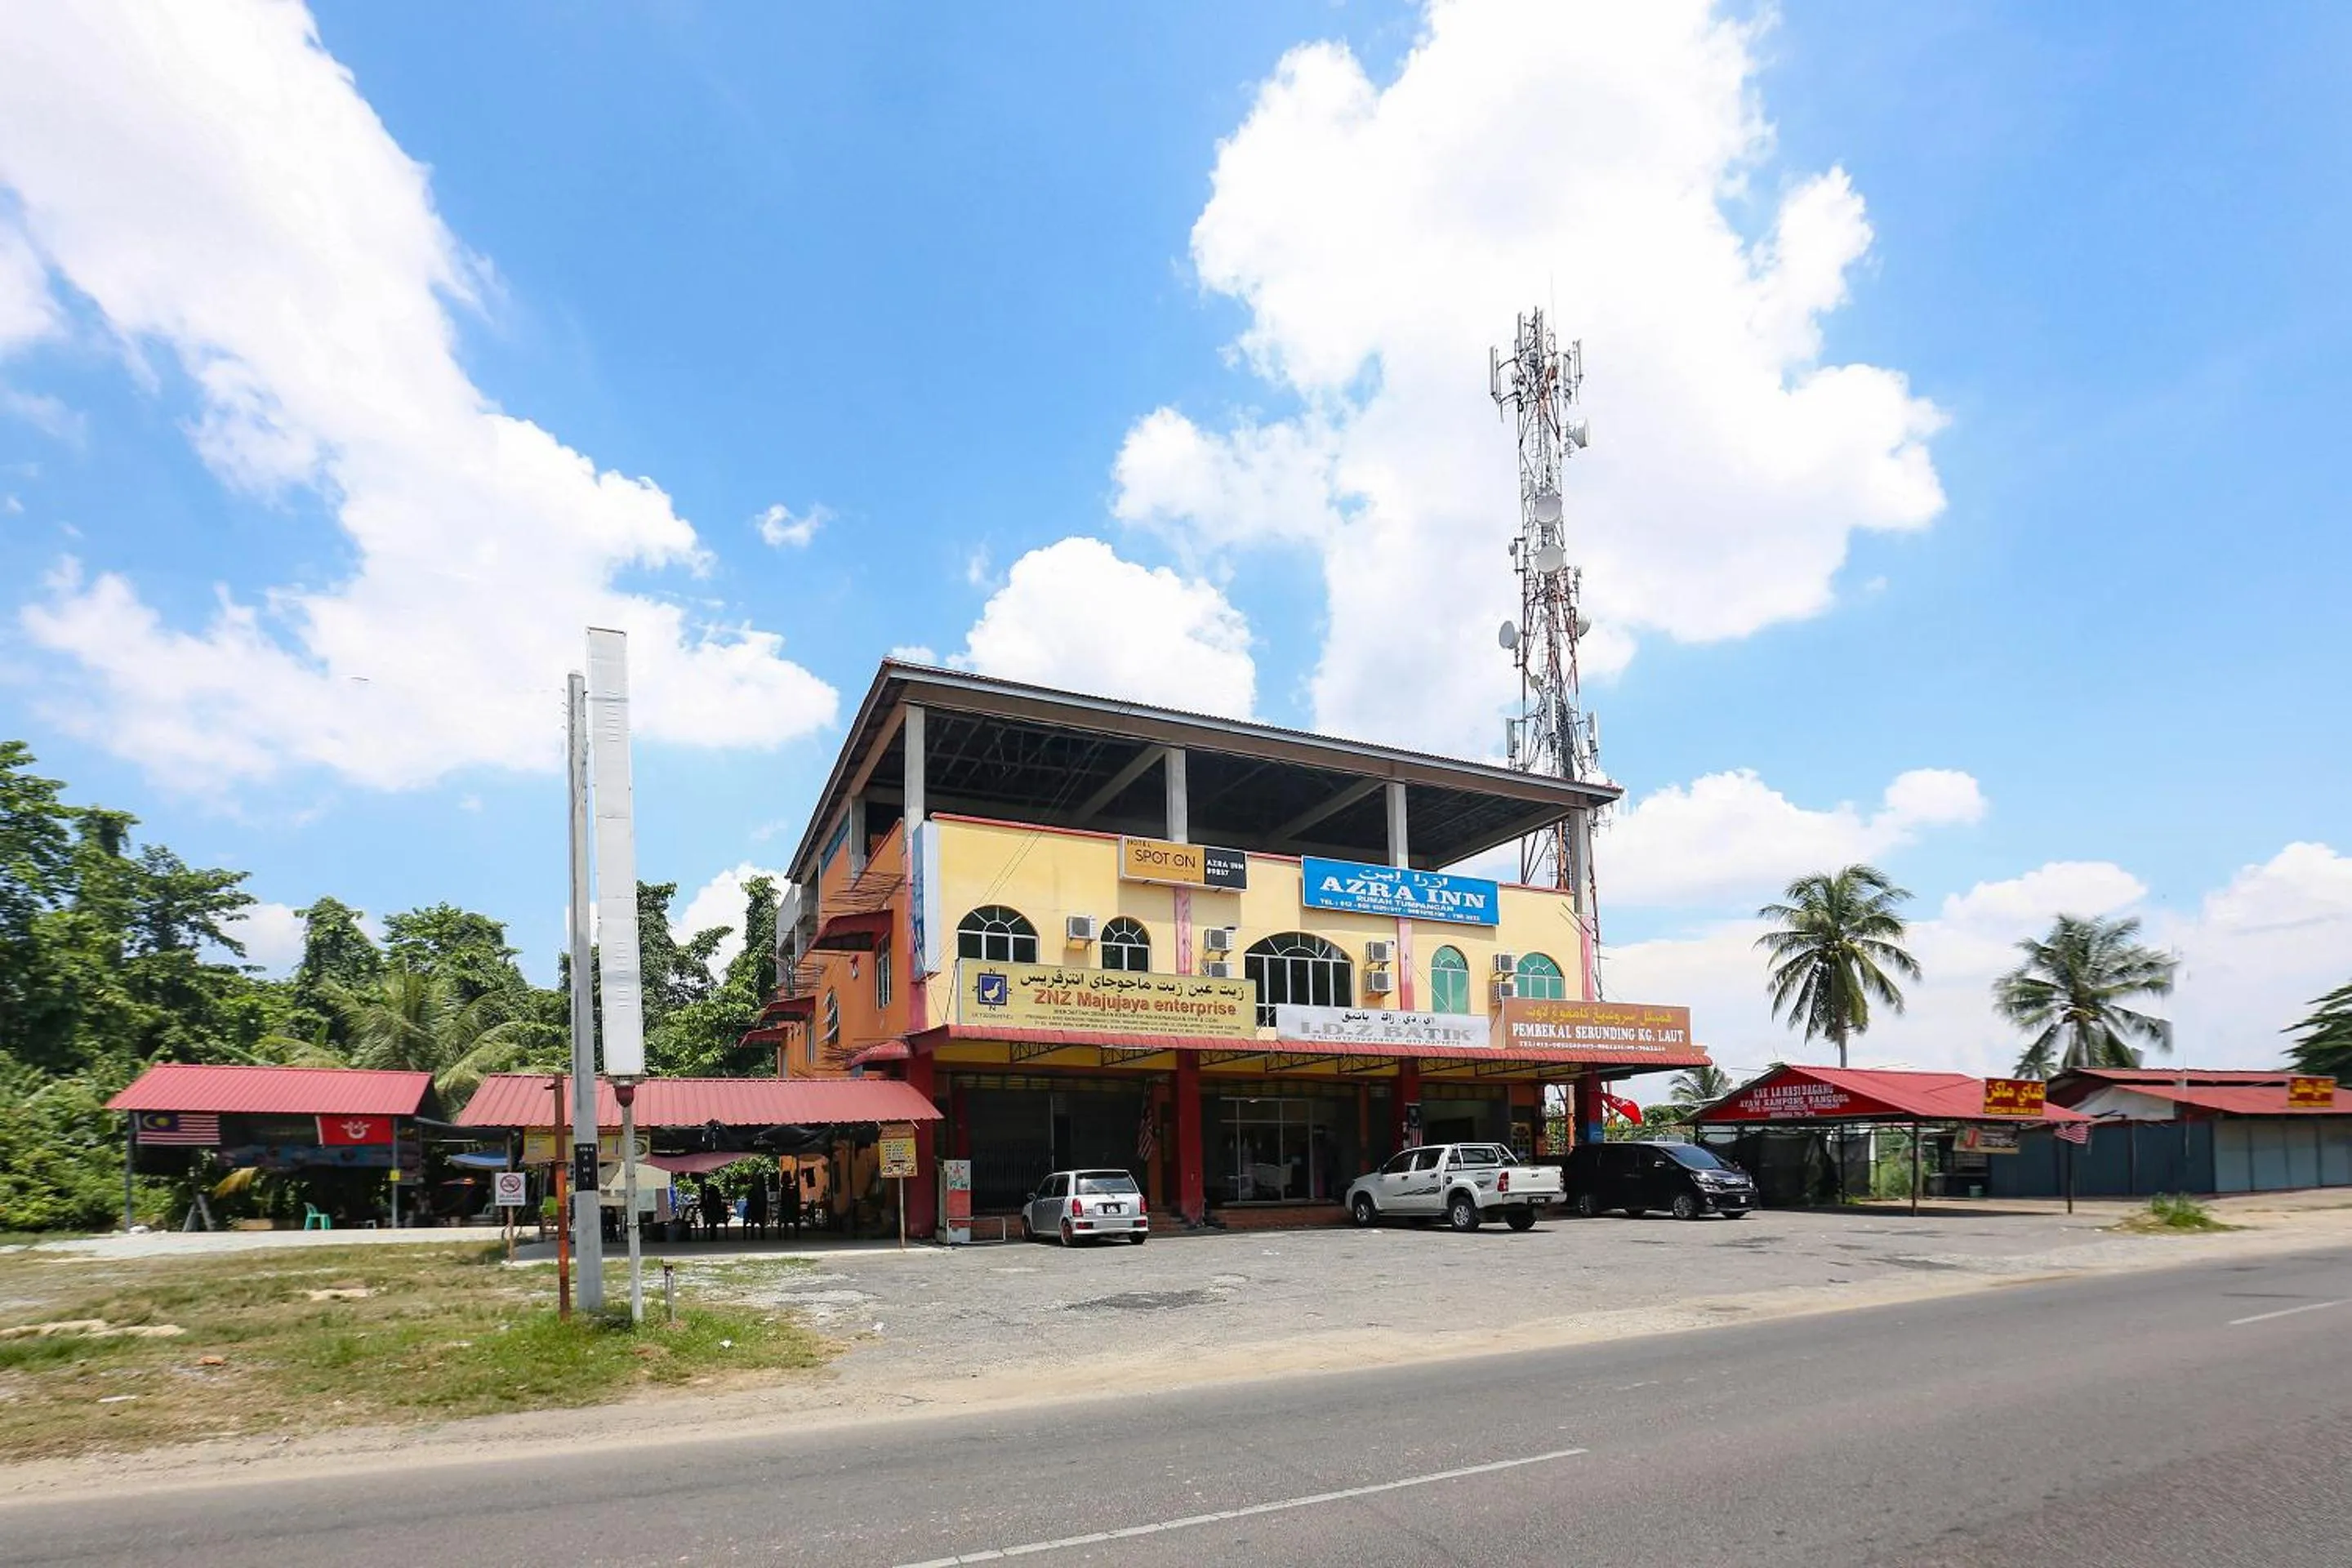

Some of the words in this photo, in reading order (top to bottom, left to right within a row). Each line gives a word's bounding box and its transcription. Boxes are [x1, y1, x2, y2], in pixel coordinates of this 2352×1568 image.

[1135, 849, 1170, 864] SPOT
[1174, 854, 1196, 868] ON
[1206, 859, 1228, 869] AZRA
[1320, 876, 1415, 902] AZRA
[1427, 888, 1486, 908] INN
[1356, 894, 1393, 906] RUMAH
[1395, 899, 1454, 912] TUMPANGAN
[1033, 989, 1072, 1005] ZNZ
[1076, 991, 1149, 1013] Majujaya
[1154, 998, 1237, 1018] enterprise
[1301, 1022, 1373, 1036] I.D.Z
[1384, 1026, 1476, 1041] BATIK
[1512, 1022, 1571, 1039] PEMBEKAL
[1575, 1025, 1635, 1040] SERUNDING
[1637, 1028, 1655, 1042] KG.
[1658, 1029, 1684, 1042] LAUT
